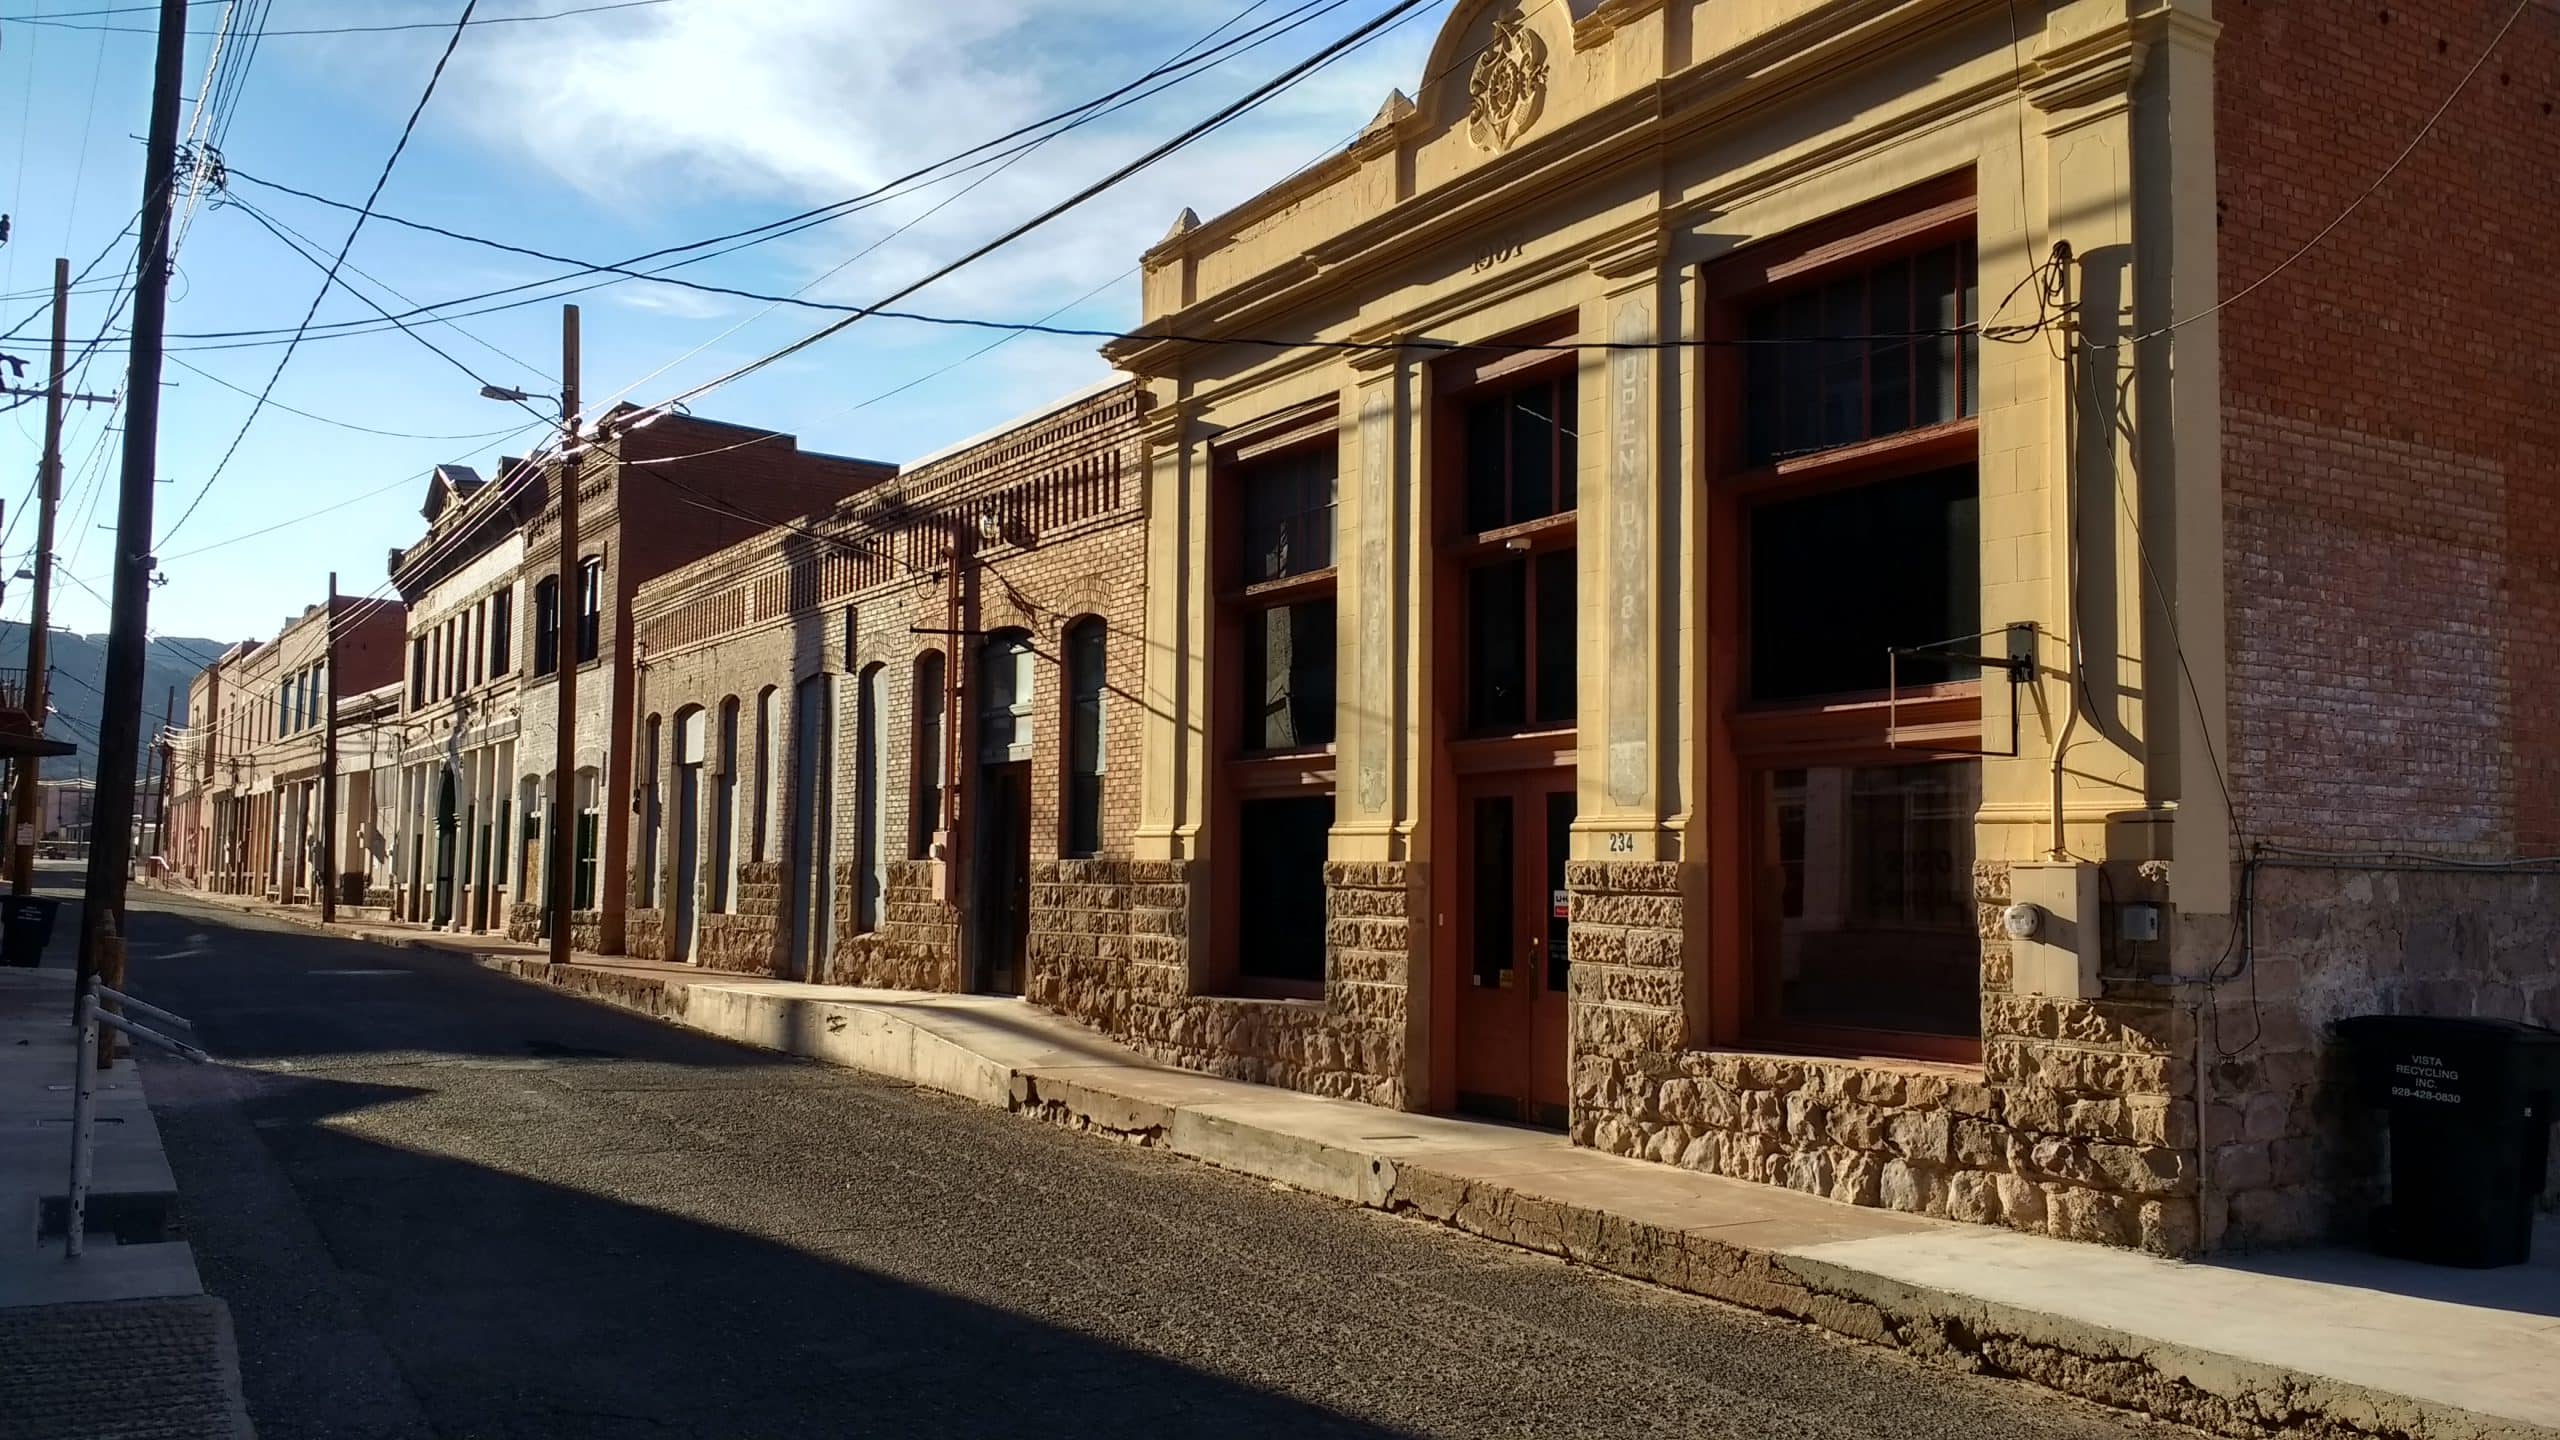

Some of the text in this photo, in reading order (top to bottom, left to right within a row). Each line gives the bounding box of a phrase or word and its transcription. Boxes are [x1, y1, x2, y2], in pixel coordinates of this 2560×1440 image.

[1609, 832, 1634, 852] 234
[2411, 1055, 2443, 1067] VISTA
[2396, 1064, 2459, 1081] RECYCLING
[2415, 1078, 2438, 1089] INC.
